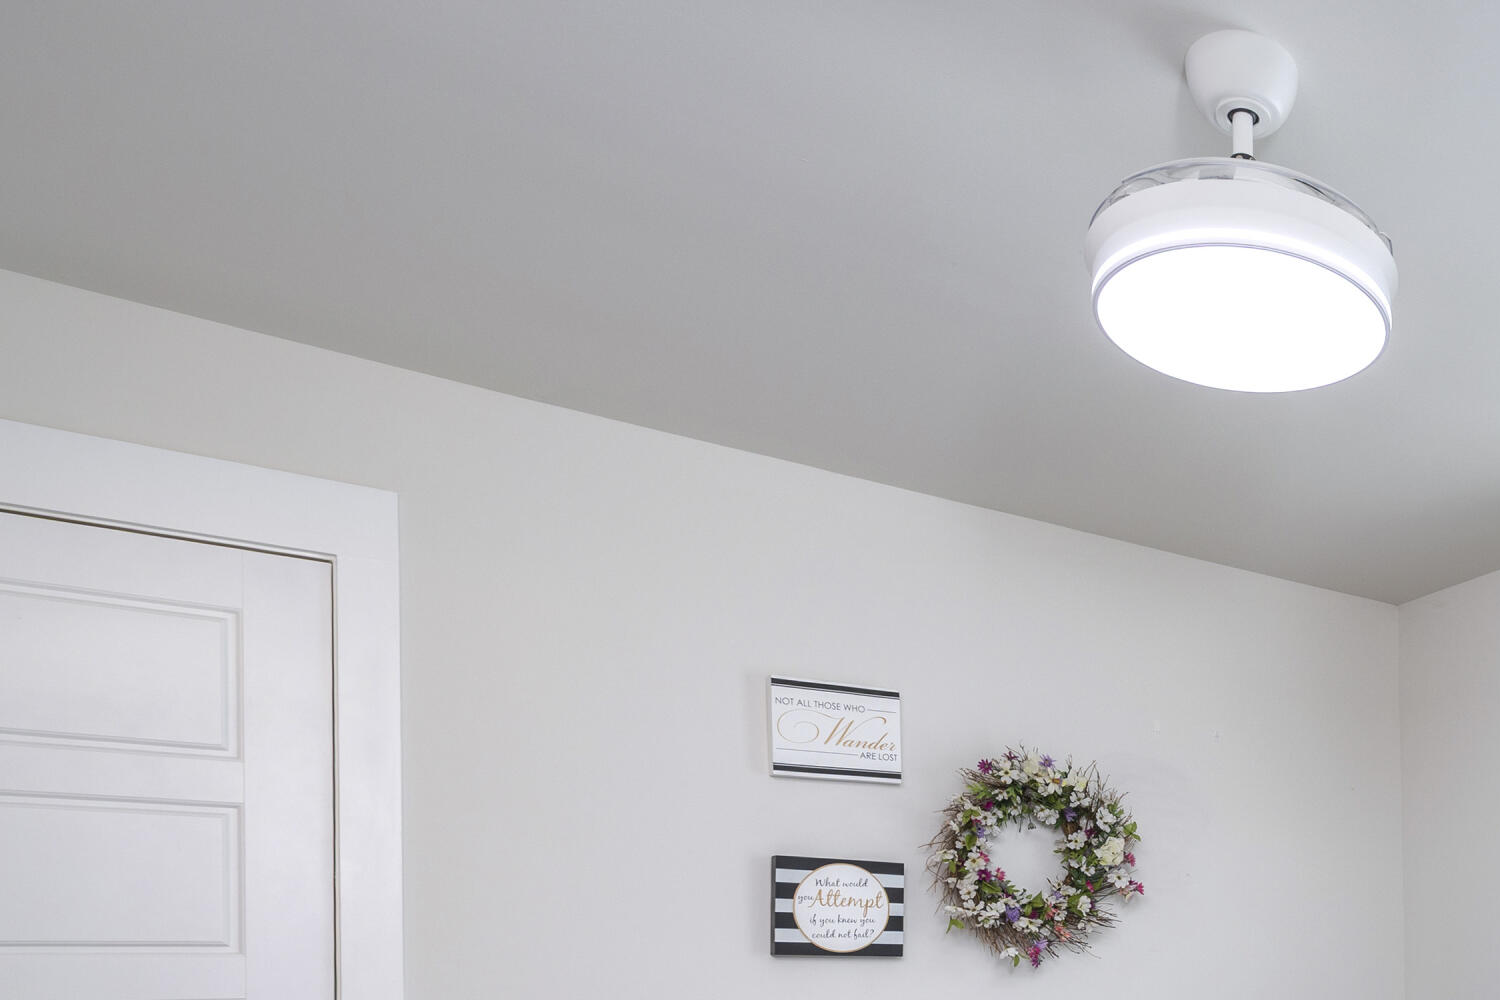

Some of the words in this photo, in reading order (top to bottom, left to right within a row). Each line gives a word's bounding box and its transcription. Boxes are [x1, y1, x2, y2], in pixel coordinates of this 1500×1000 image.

[775, 697, 794, 706] NOT
[797, 699, 812, 708] ALL
[814, 700, 841, 711] THOSE
[843, 704, 866, 713] WHO
[777, 709, 897, 751] Wander
[860, 752, 876, 760] ARE
[878, 753, 897, 762] LOST
[815, 877, 840, 888] What
[842, 878, 869, 888] would
[798, 895, 814, 904] you
[808, 889, 884, 918] Attempt
[809, 913, 817, 925] if
[820, 918, 835, 927] you
[837, 914, 857, 924] knew
[860, 918, 875, 927] you
[812, 929, 835, 939] could
[838, 931, 851, 939] not
